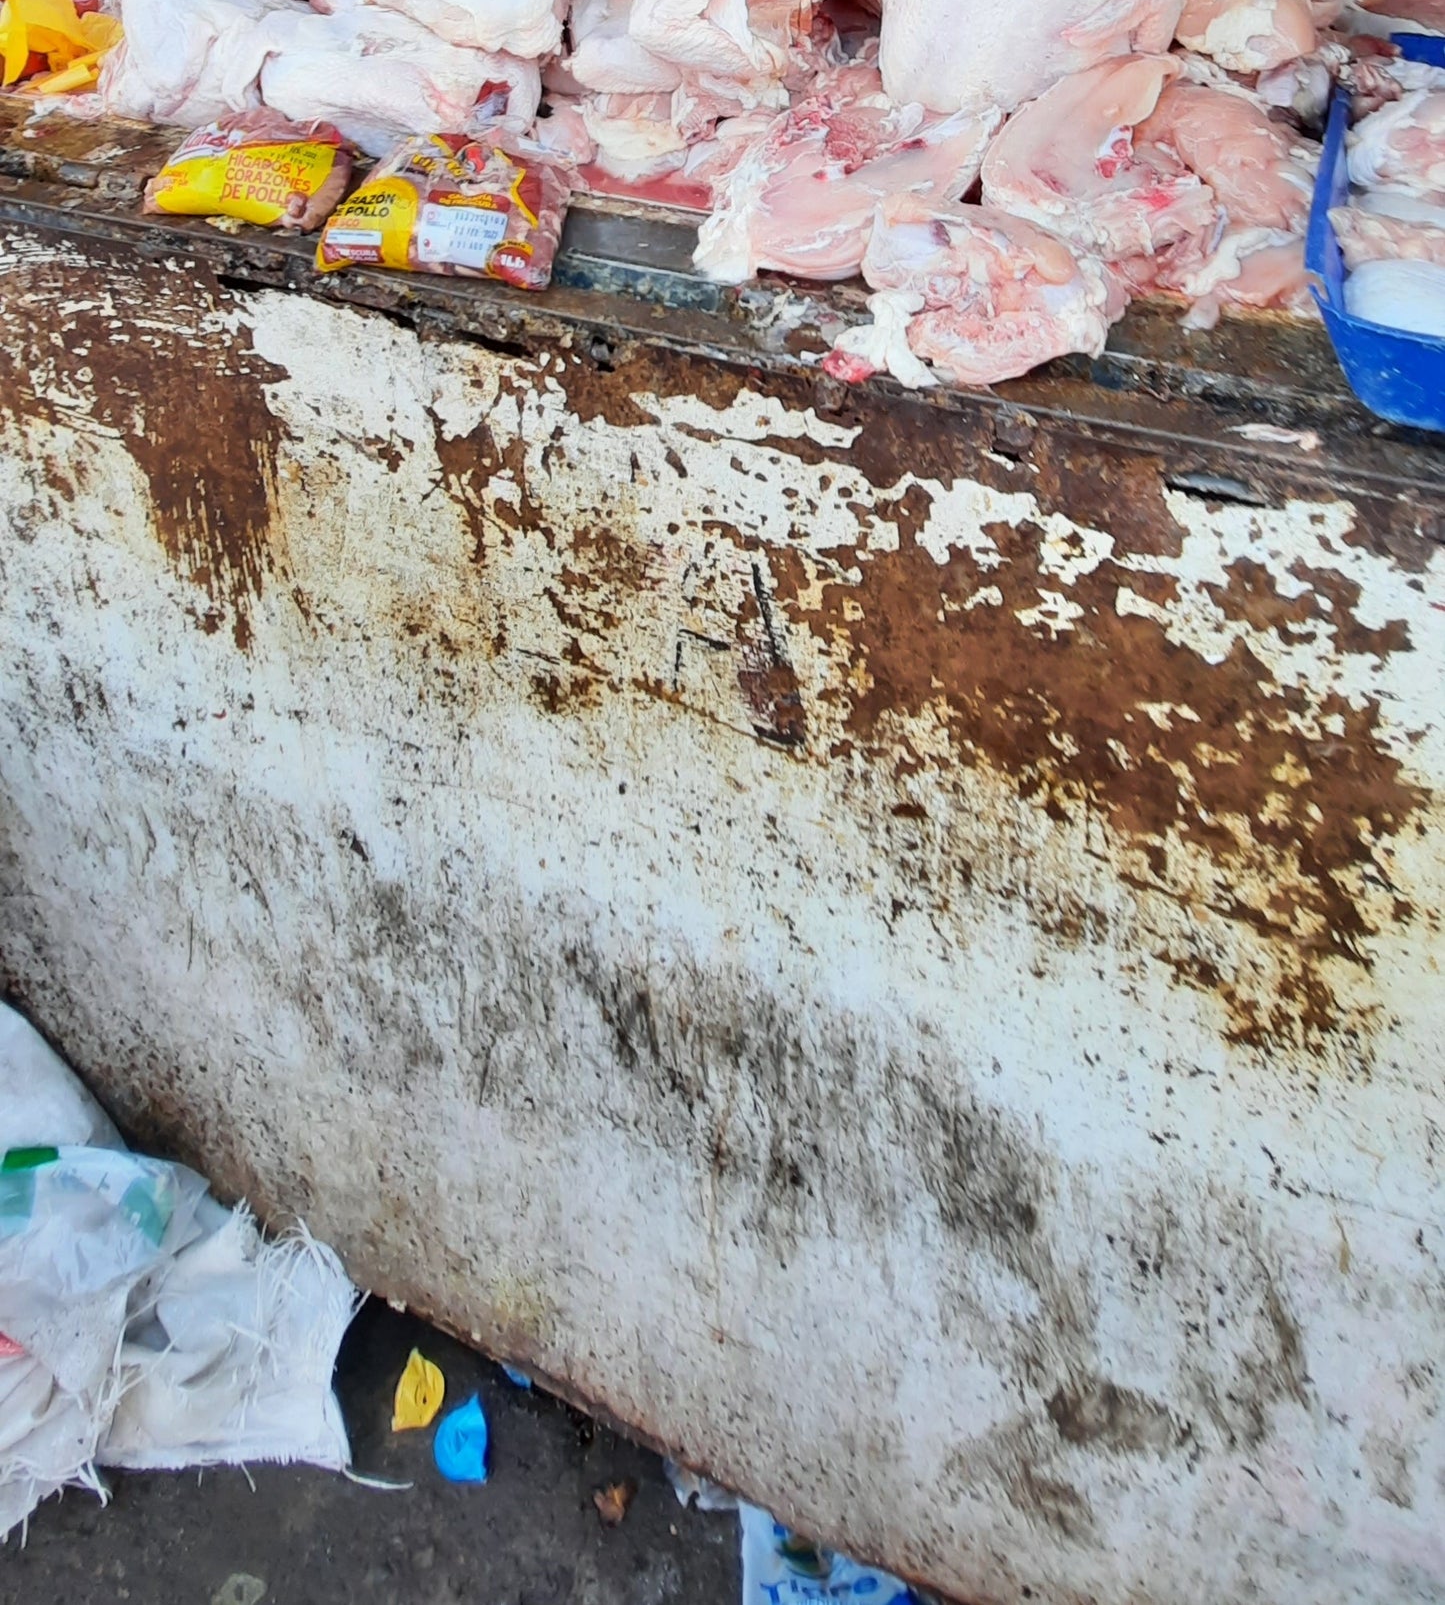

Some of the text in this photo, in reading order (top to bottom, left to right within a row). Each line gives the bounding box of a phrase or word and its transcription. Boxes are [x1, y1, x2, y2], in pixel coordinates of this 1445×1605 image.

[297, 165, 307, 177] Y
[225, 167, 311, 192] CORAZONES
[219, 183, 242, 202] DE
[345, 206, 389, 218] POLLO
